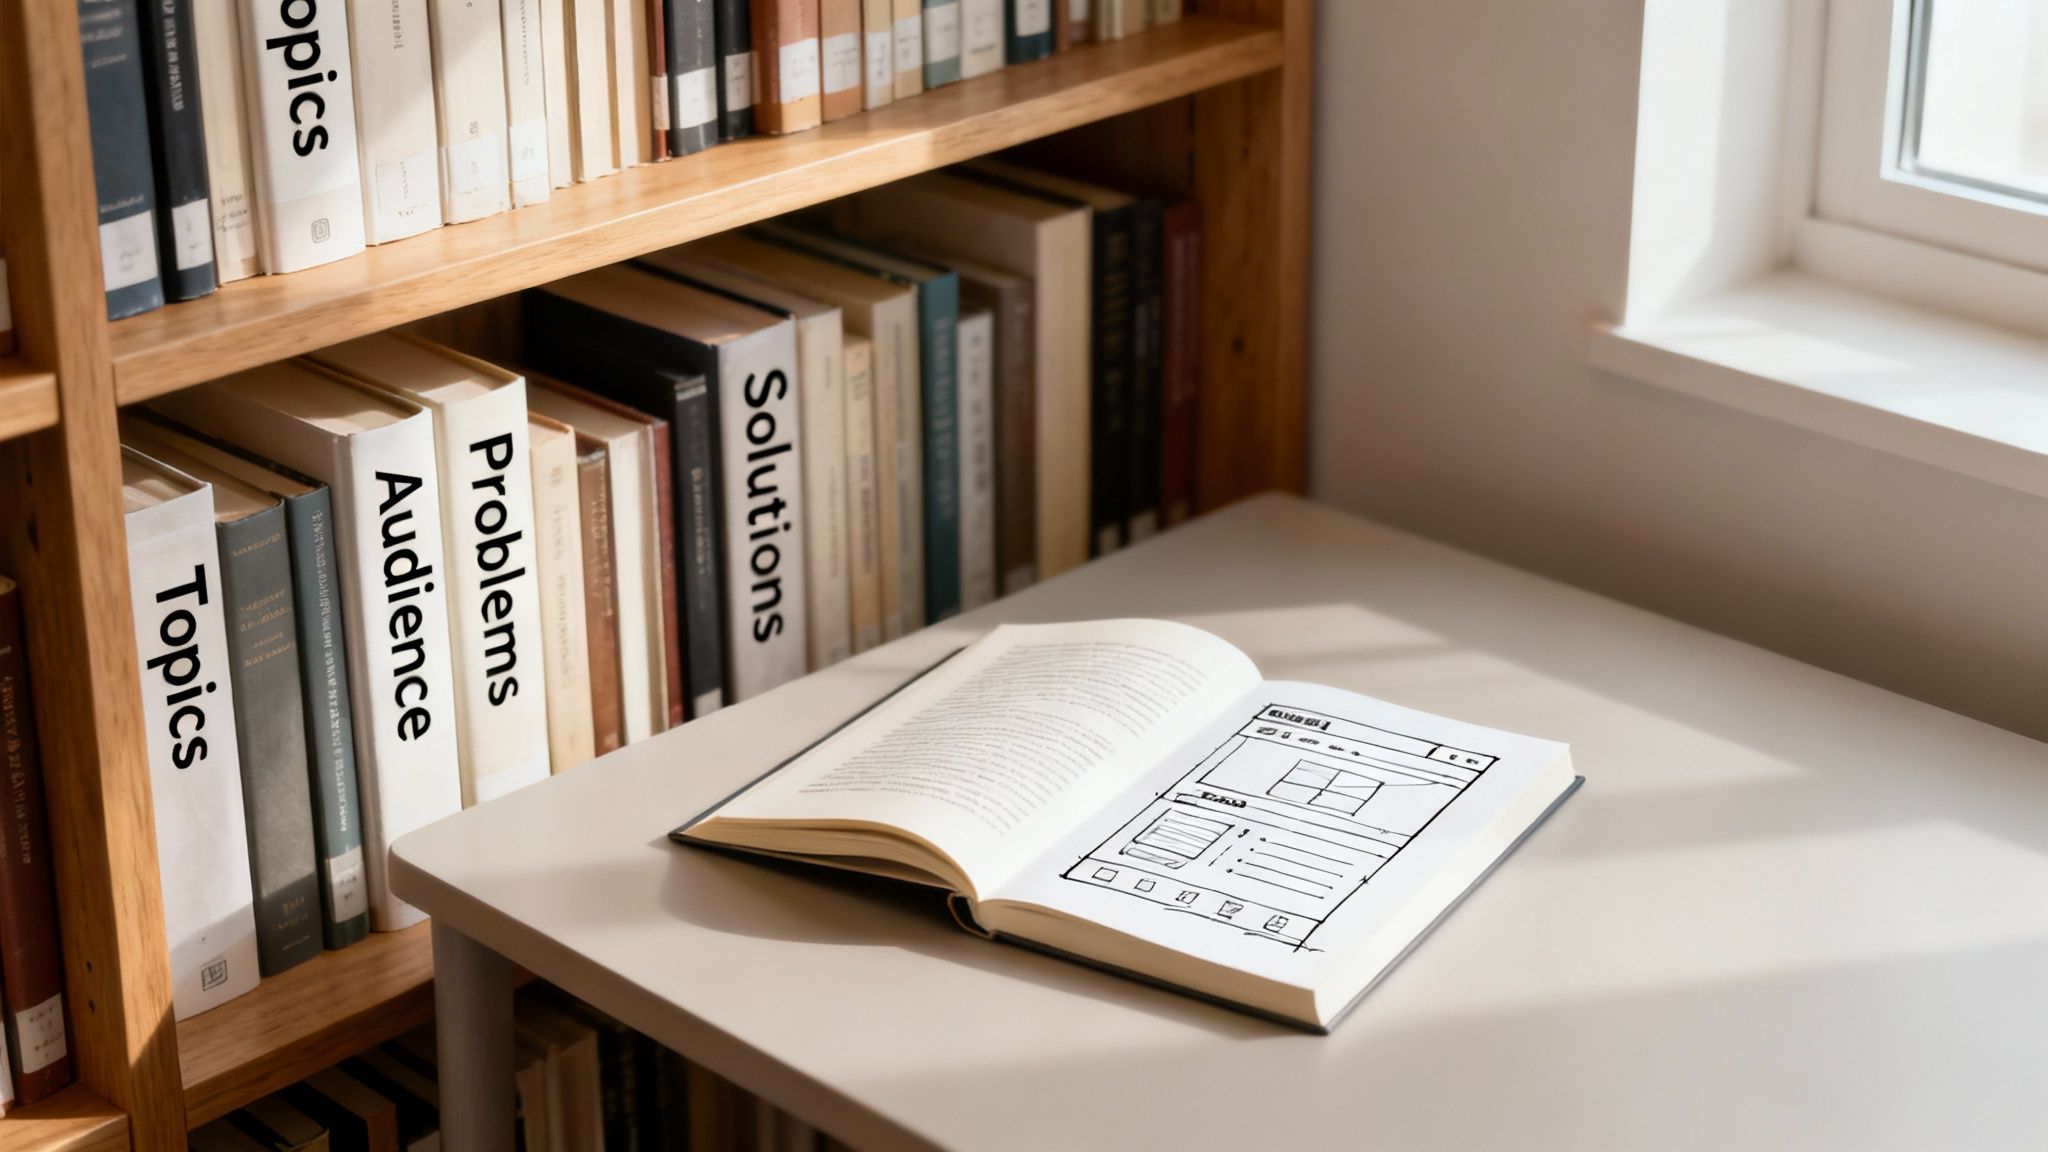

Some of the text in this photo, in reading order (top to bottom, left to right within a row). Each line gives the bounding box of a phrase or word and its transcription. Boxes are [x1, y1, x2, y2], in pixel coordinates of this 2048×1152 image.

[375, 471, 435, 742] Audience
[469, 432, 526, 707] Problems
[744, 369, 792, 643] Solutions
[146, 563, 216, 770] Topics
